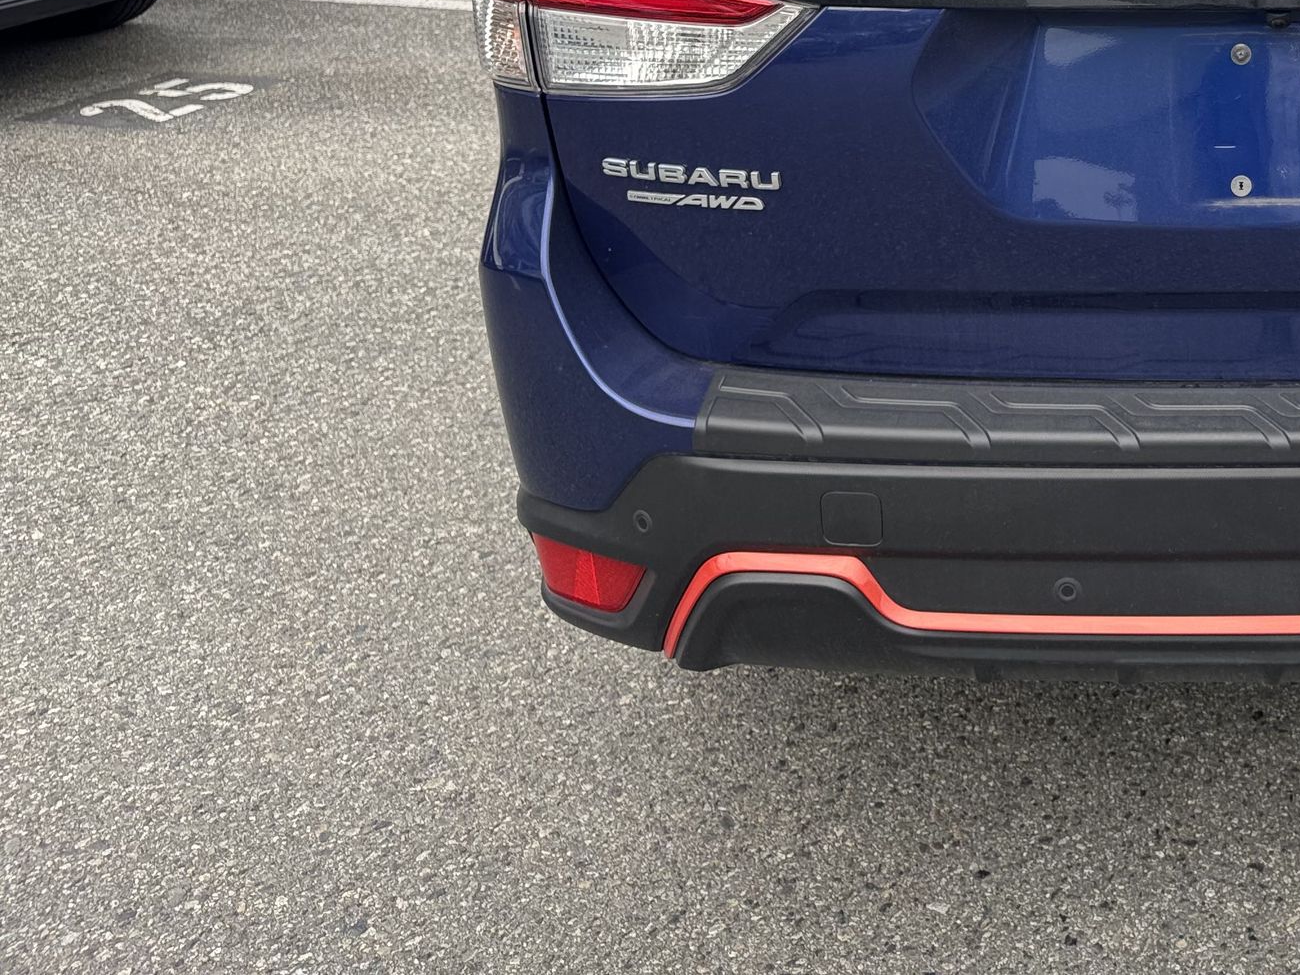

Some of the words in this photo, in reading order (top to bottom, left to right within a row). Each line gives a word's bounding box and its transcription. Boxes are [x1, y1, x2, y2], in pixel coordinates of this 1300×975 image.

[79, 78, 254, 123] 25
[601, 157, 782, 191] SUBARU
[676, 194, 765, 211] AWD
